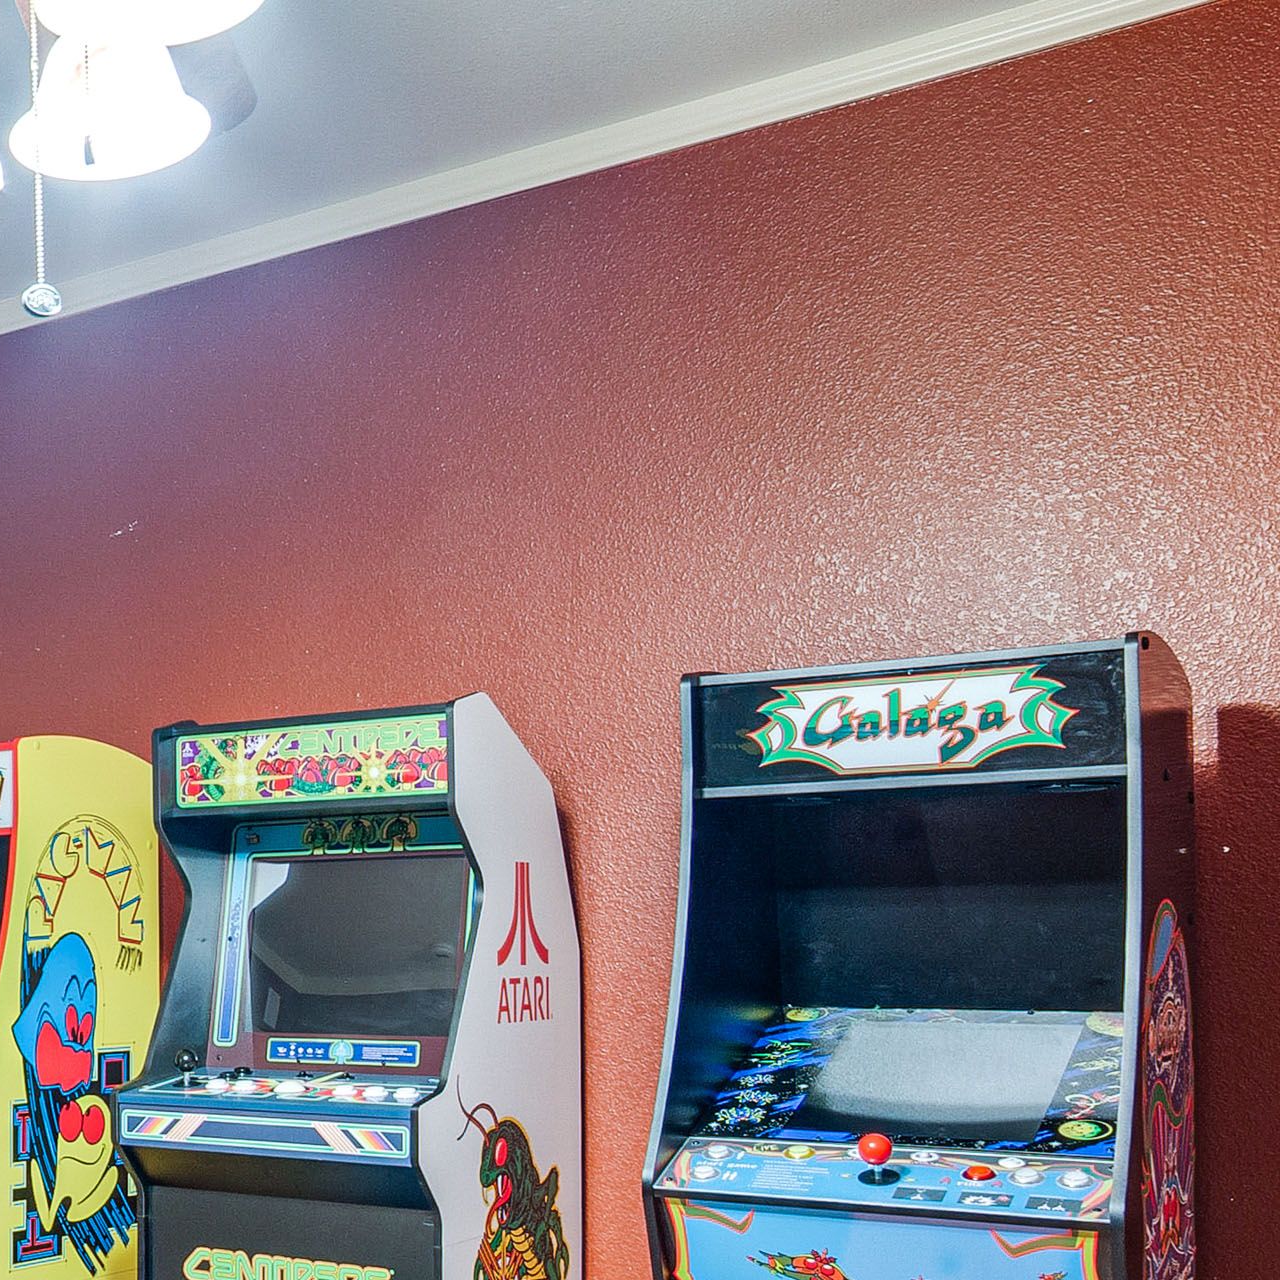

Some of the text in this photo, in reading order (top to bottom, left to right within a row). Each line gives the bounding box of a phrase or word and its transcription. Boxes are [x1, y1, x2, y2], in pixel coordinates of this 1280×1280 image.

[276, 720, 448, 759] CENTIPEDE
[802, 688, 1015, 767] Galaga
[25, 827, 144, 944] PAC-MAN
[497, 975, 551, 1025] ATARI
